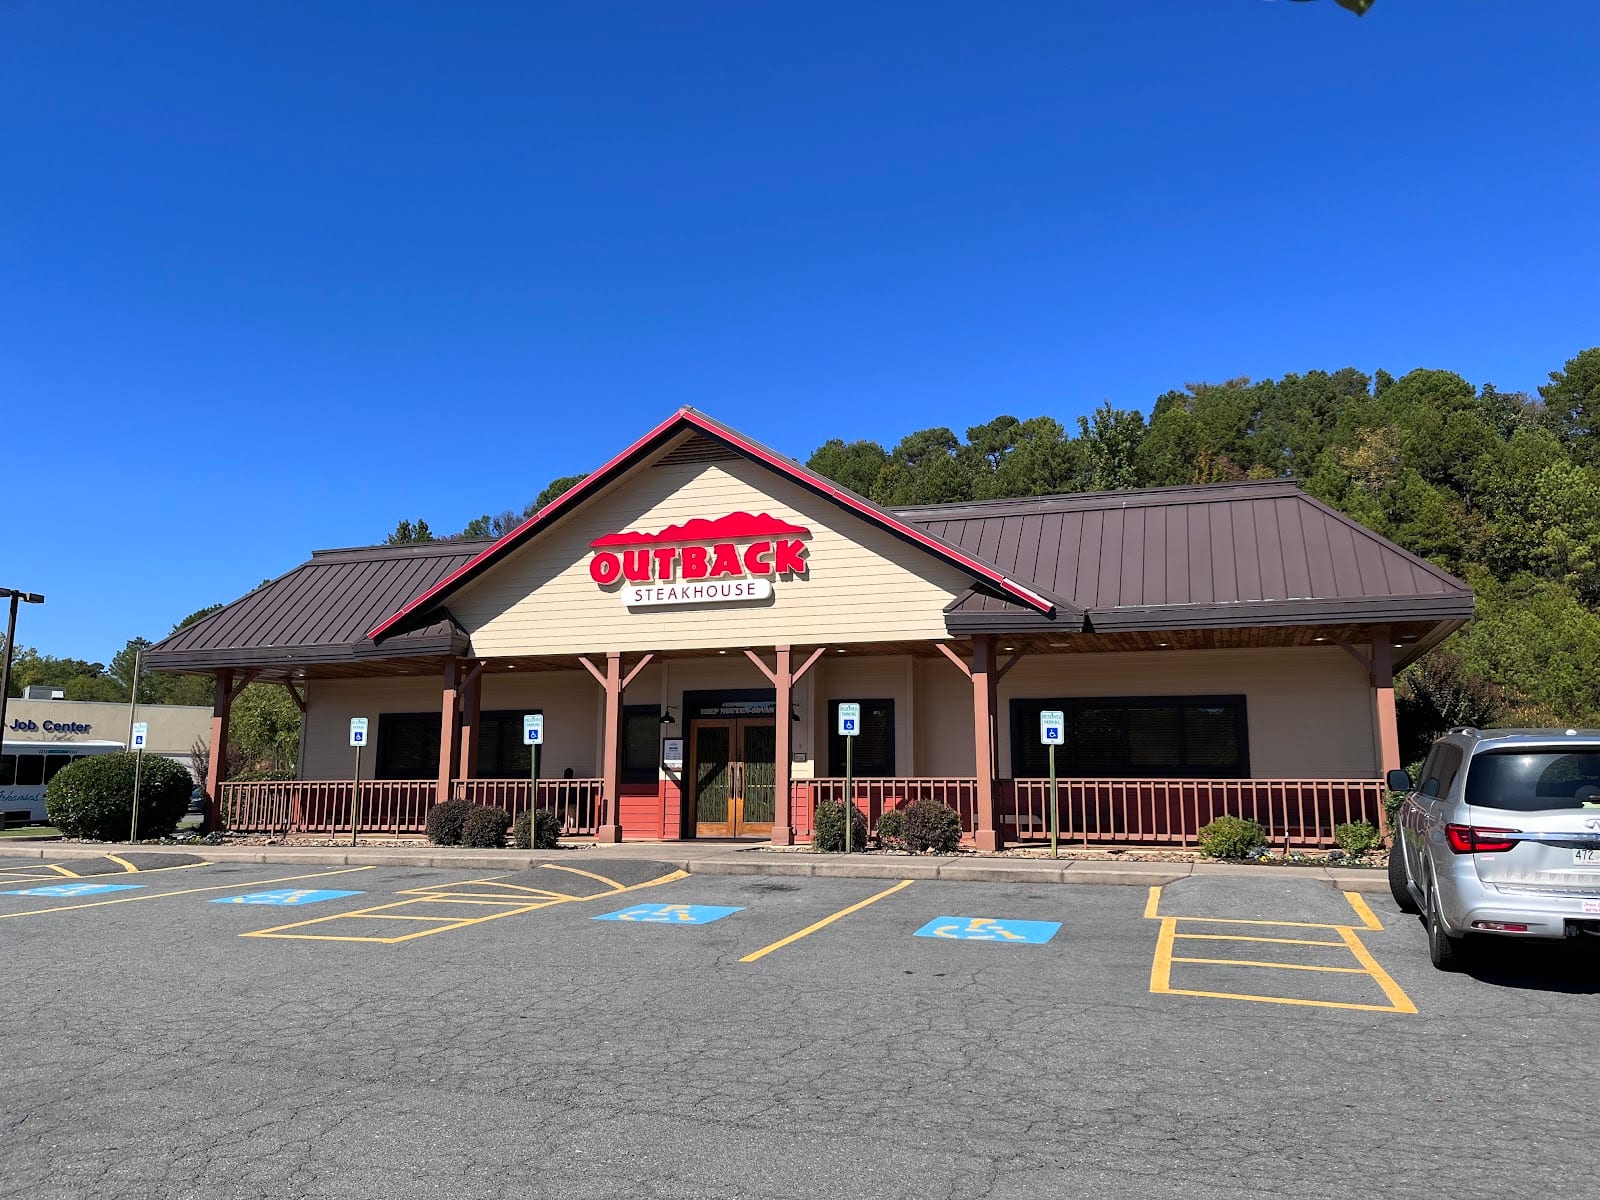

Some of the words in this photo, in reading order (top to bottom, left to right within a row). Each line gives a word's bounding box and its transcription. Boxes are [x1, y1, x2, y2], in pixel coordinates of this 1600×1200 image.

[589, 538, 807, 585] OUTBACK
[635, 582, 757, 602] STEAKHOUSE
[9, 718, 37, 731] Job
[42, 719, 92, 733] Center
[1575, 849, 1594, 861] 472
